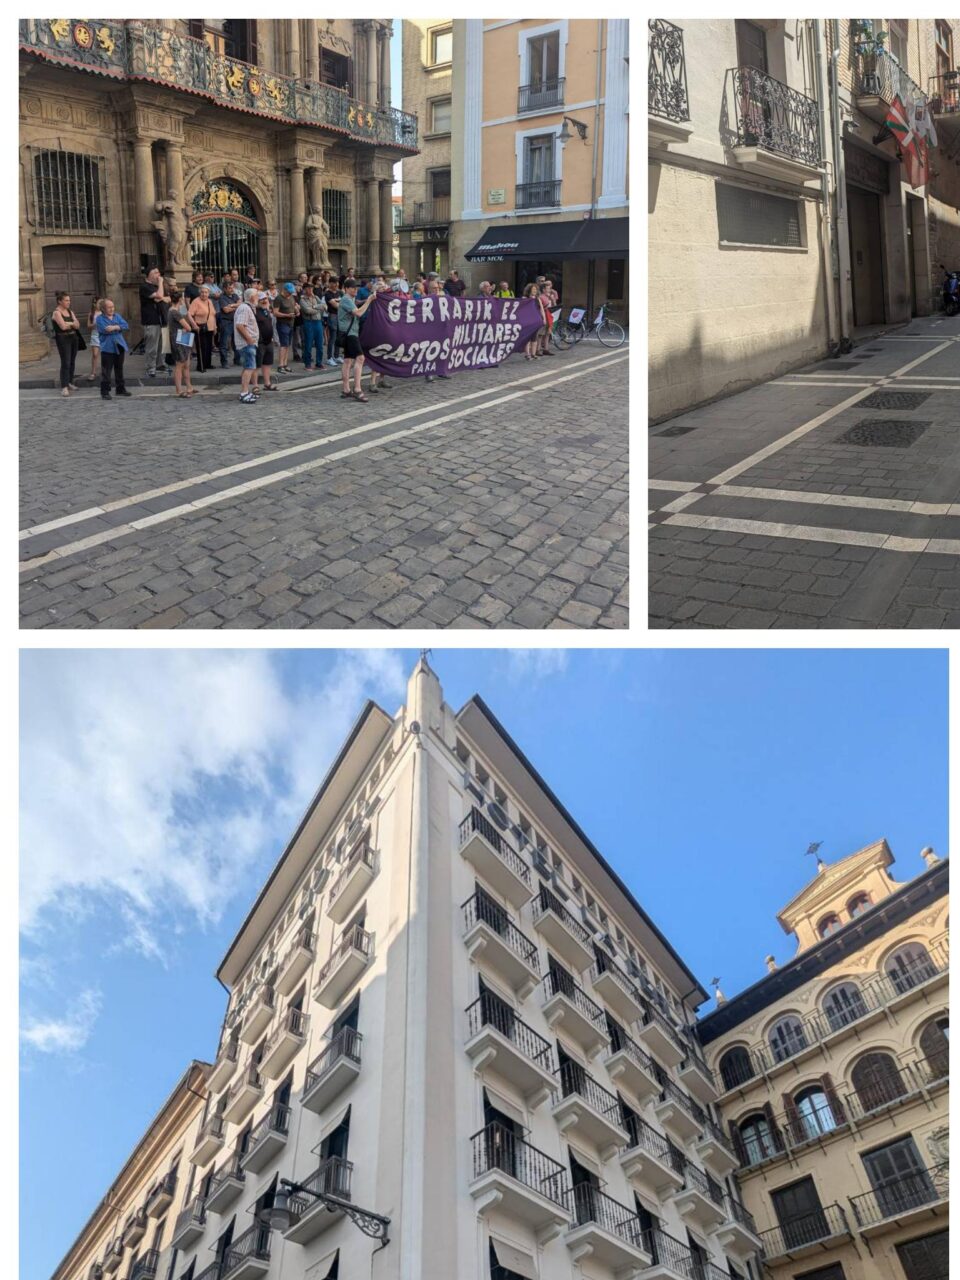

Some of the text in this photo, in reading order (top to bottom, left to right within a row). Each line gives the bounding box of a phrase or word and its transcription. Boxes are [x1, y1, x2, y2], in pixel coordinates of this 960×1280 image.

[387, 297, 520, 323] GERRARIK EZ
[368, 323, 522, 363] GASTOS MILITARES
[411, 342, 515, 374] PARA SOCIALES
